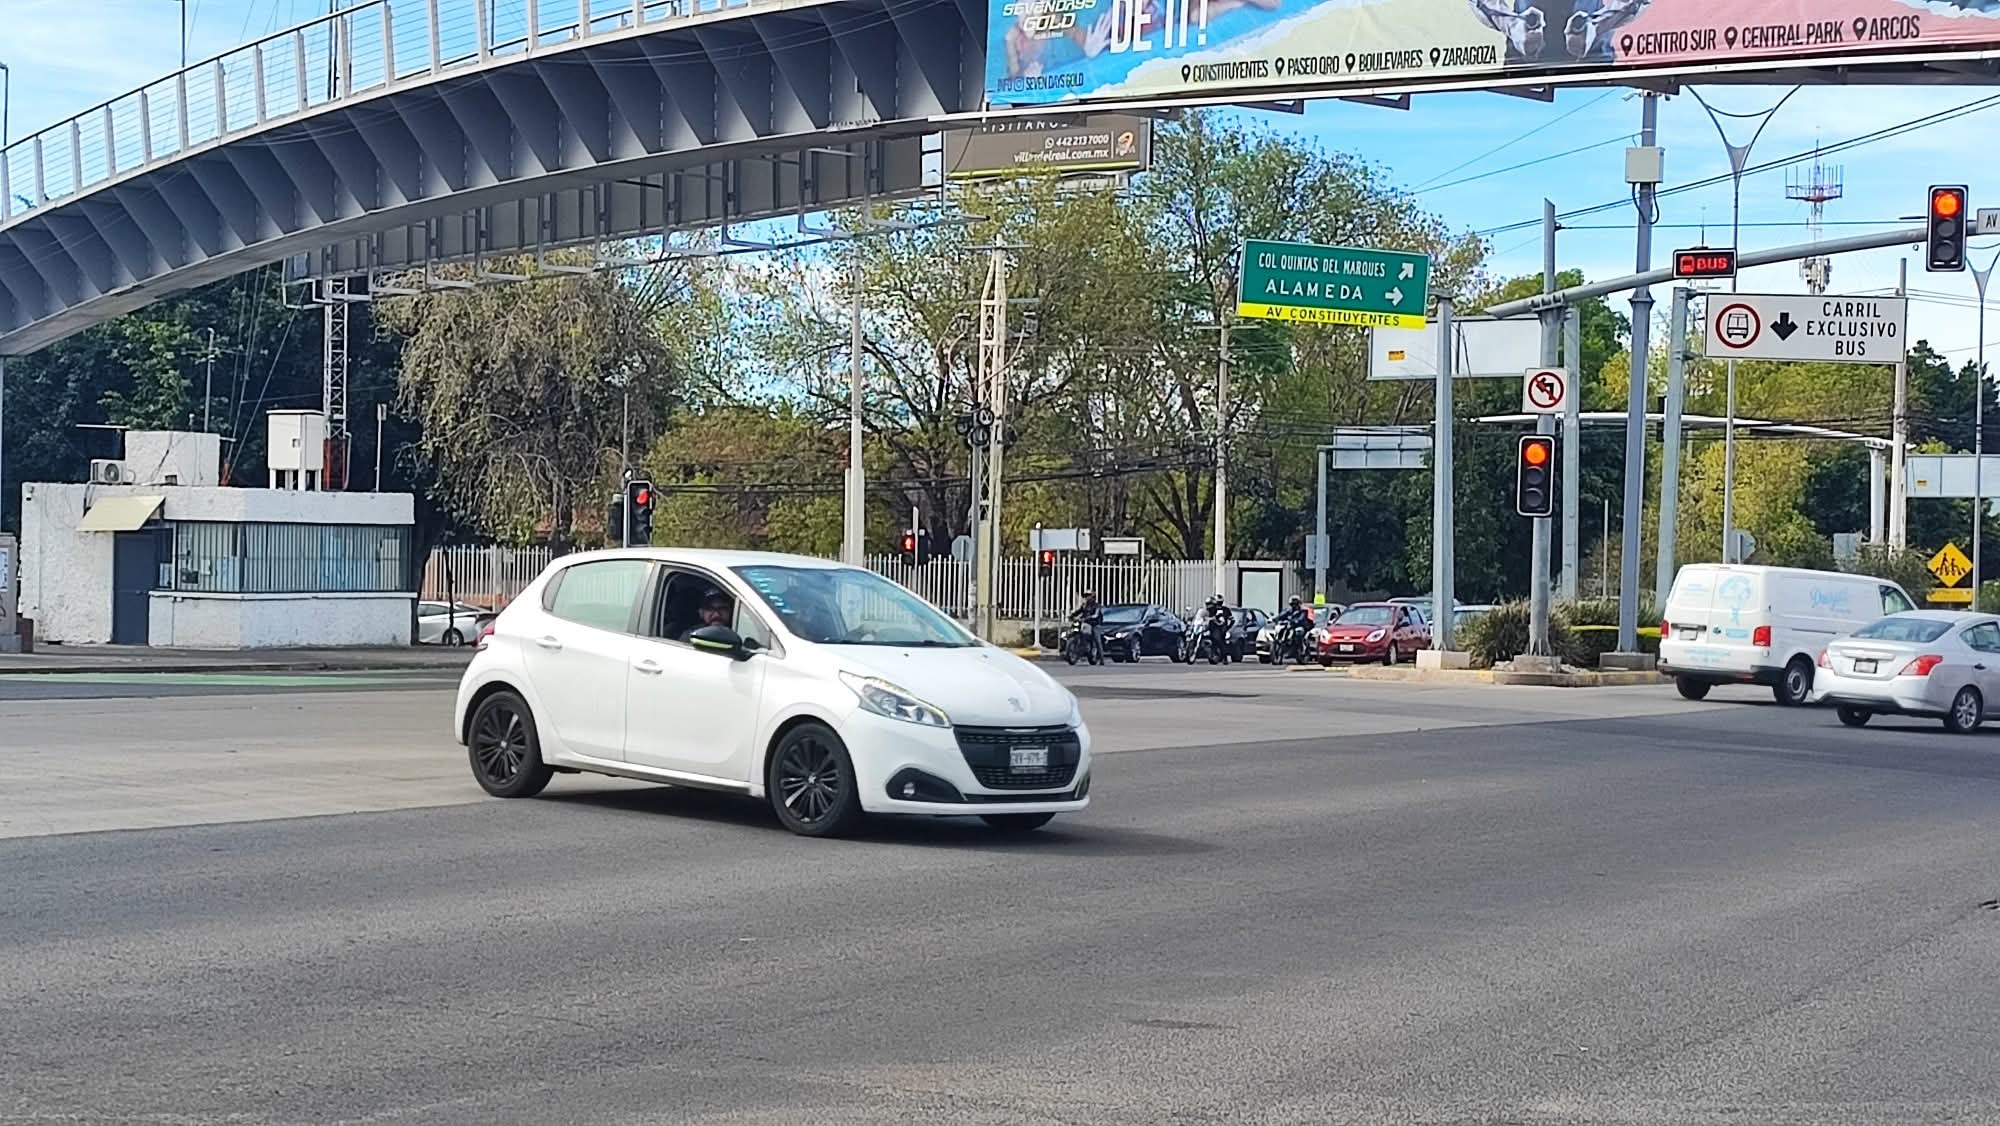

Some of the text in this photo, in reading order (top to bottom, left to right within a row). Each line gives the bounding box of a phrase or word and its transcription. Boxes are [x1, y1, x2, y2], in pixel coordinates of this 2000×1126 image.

[1023, 13, 1076, 32] GOLD
[1110, 0, 1152, 54] DE
[1869, 15, 1920, 39] ARCOS
[1636, 29, 1716, 55] CENTRO SUR
[1742, 21, 1844, 48] CENTRAL PARK
[1288, 55, 1340, 76] PASEO QRO
[1359, 50, 1423, 72] BOULEVARES
[1442, 45, 1497, 67] ZARAGOZA
[1065, 72, 1084, 88] GOLD
[1193, 60, 1269, 83] CONSTITUYENTES
[1088, 134, 1109, 144] 7000
[1986, 213, 1998, 229] AV
[1258, 252, 1386, 278] COL QUINTAS DEL MARQUES
[1697, 258, 1728, 269] BUS
[1265, 279, 1363, 301] ALAMEDA
[1266, 306, 1400, 327] AV CONSTITUYENTES
[1823, 302, 1881, 318] CARRIL
[1806, 320, 1897, 338] EXCLUSIVO
[1835, 340, 1866, 356] BUS
